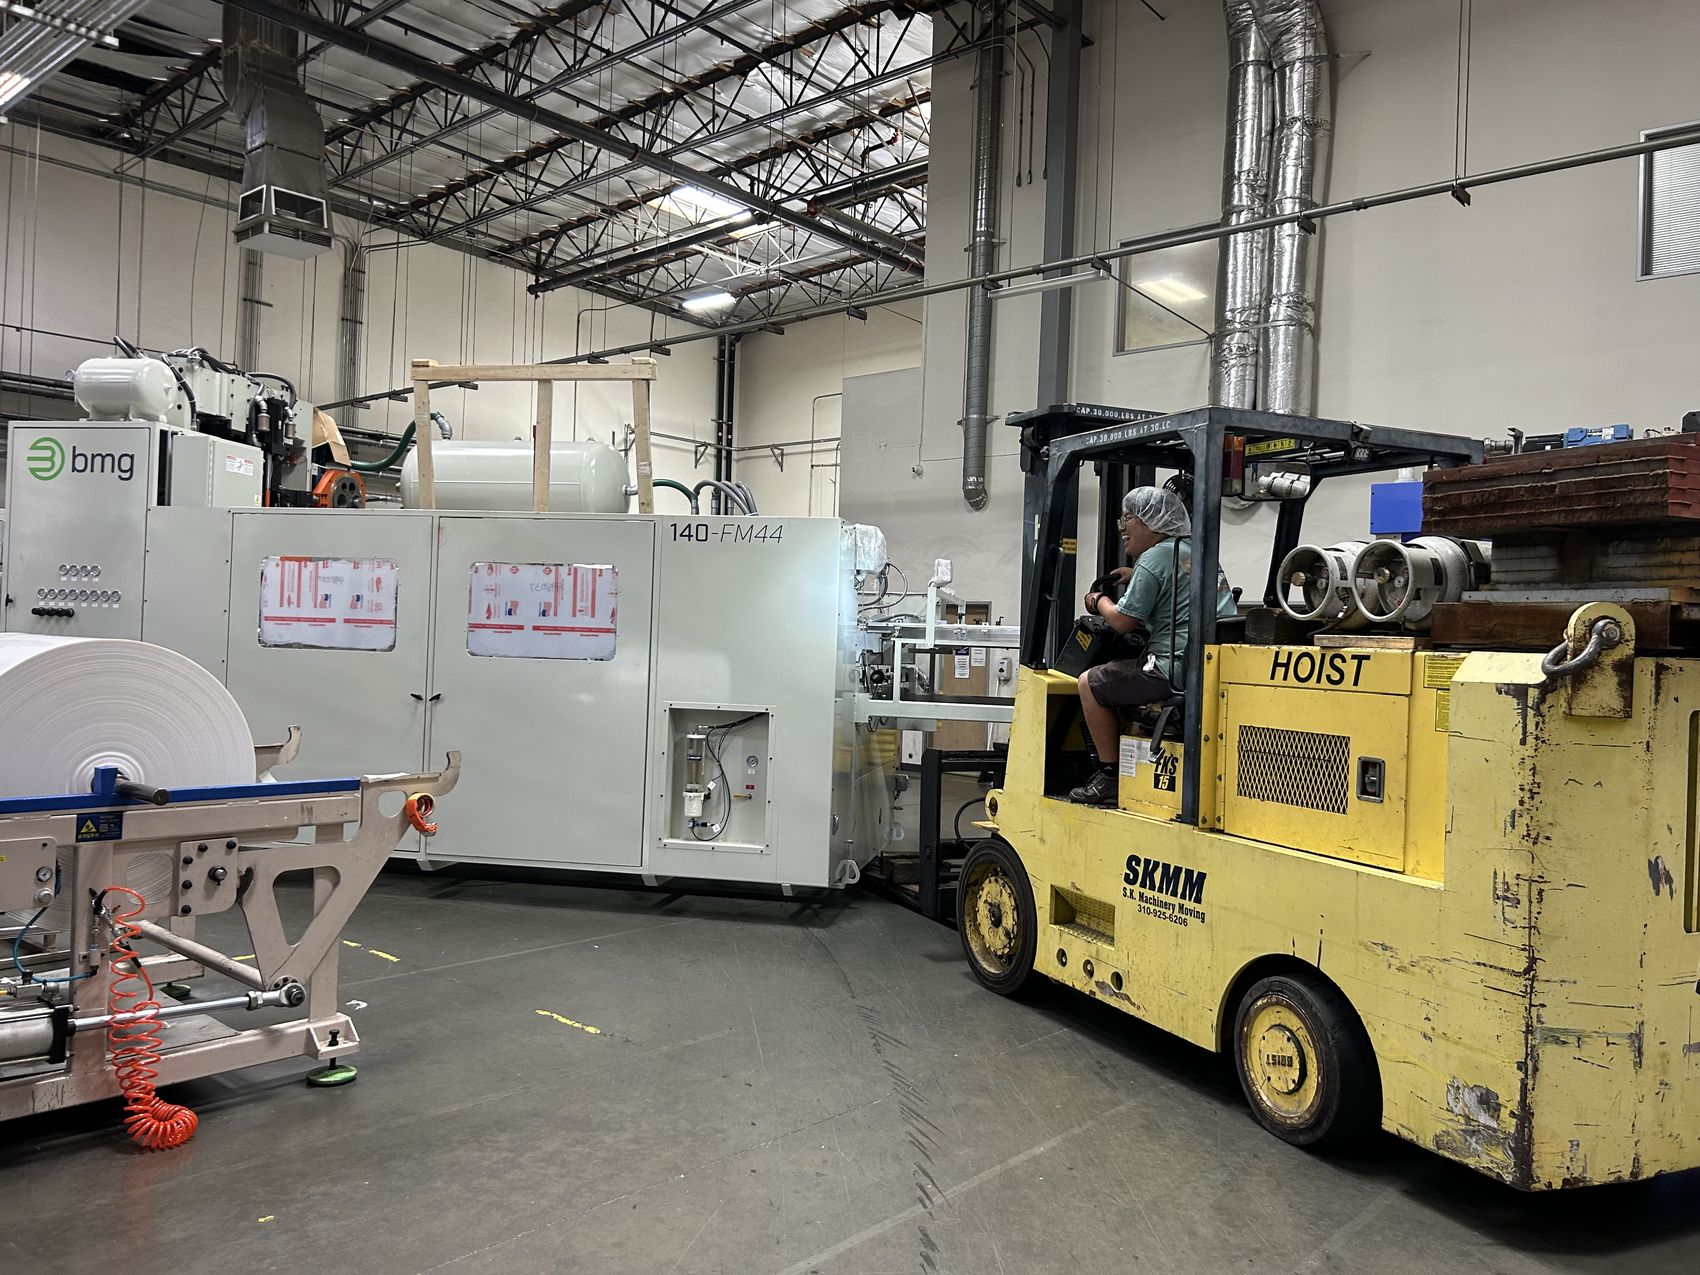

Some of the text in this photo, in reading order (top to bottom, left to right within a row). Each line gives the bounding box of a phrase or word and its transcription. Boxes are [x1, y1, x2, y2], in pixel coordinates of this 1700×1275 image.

[71, 445, 135, 481] bmg
[670, 523, 783, 543] 140-FM44
[1270, 651, 1371, 687] HOIST
[1158, 775, 1170, 790] 15
[1123, 854, 1207, 904] SKMM
[1122, 886, 1205, 923] S.K. Machinery Moving
[1138, 904, 1188, 926] 310-925-6206
